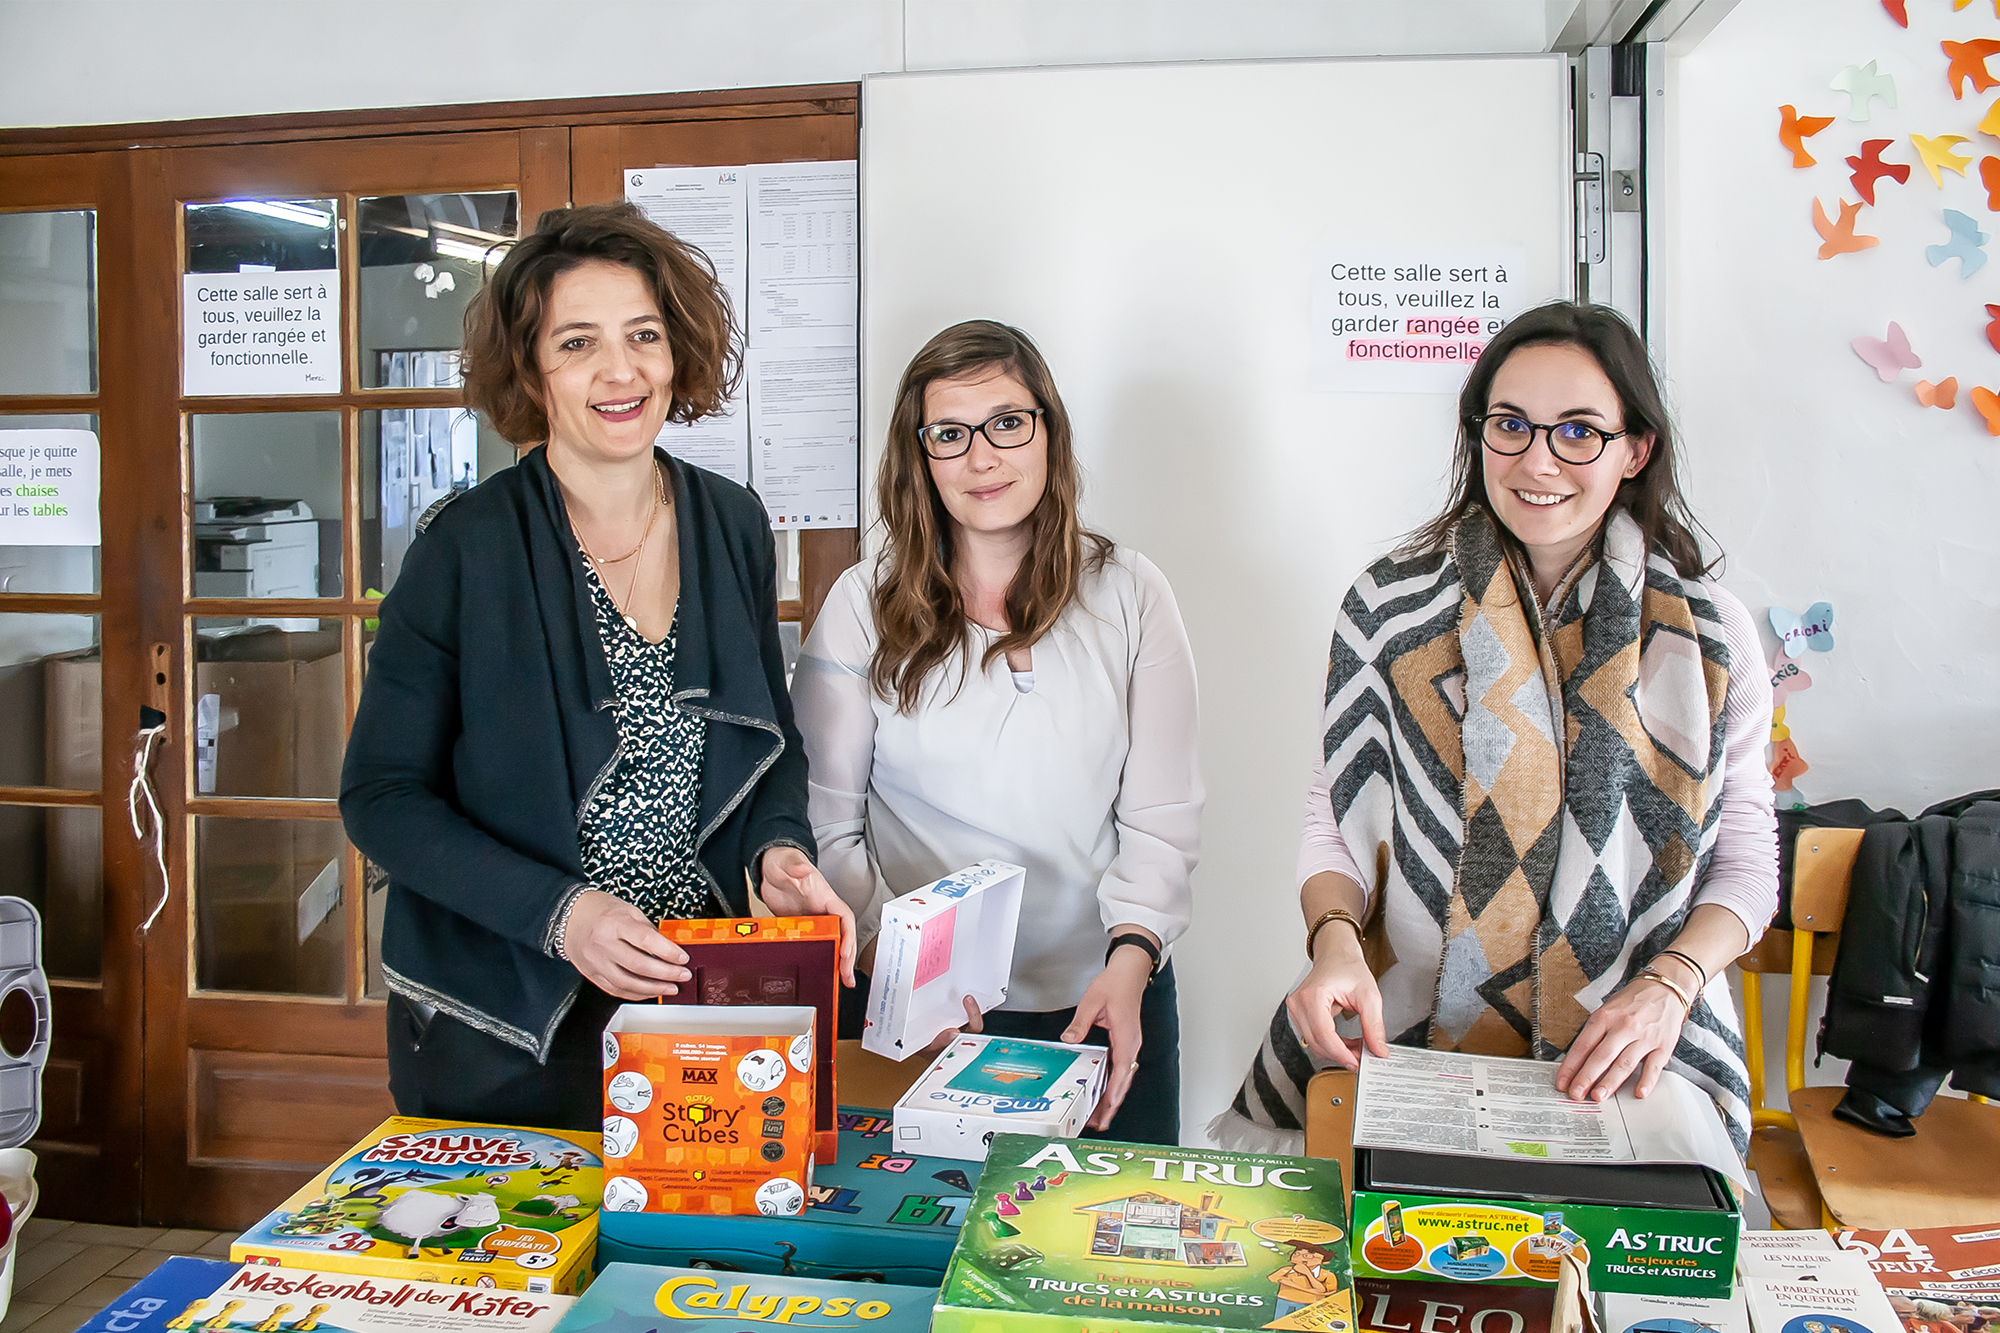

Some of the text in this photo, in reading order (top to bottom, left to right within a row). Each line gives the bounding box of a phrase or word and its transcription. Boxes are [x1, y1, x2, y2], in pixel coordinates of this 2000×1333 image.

[1331, 263, 1508, 283] Cette salle sert à
[197, 284, 328, 302] Cette salle sert à
[1338, 290, 1500, 309] tous, veuillez la
[202, 306, 321, 325] tous, veuillez la
[1331, 315, 1399, 336] garder
[1406, 316, 1480, 338] rangée
[198, 328, 326, 348] garder rangée et
[210, 350, 313, 366] fonctionnelle.
[0, 445, 78, 461] sque je quitte
[30, 465, 42, 480] je
[45, 467, 72, 477] mets
[0, 484, 59, 497] es chaises
[0, 503, 69, 516] ur les tables
[682, 1069, 718, 1082] MAX
[663, 1124, 739, 1144] Cubes
[382, 1135, 517, 1153] SAUVE
[366, 1148, 533, 1164] MOUTONS
[1202, 1154, 1235, 1162] TOUTE
[1252, 1158, 1295, 1166] FAMILLE
[1418, 1218, 1529, 1232] www.astruc.net
[328, 1232, 377, 1252] 3D
[1627, 1254, 1646, 1264] Les
[1676, 1258, 1698, 1266] des
[1606, 1264, 1716, 1279] TRUCS et ASTUCES
[1098, 1273, 1193, 1289] Le jeu des
[228, 1271, 416, 1308] Maskenball
[414, 1289, 455, 1304] der
[1026, 1276, 1264, 1307] TRUCS et ASTUCES
[1766, 1284, 1860, 1296] LA PARENTALITÉ
[1890, 1288, 1904, 1296] et
[1933, 1292, 2000, 1301] coopérat
[654, 1276, 891, 1328] Calypso
[1063, 1294, 1221, 1316] de la maison
[1794, 1294, 1856, 1304] QUESTION
[105, 1297, 168, 1333] cta
